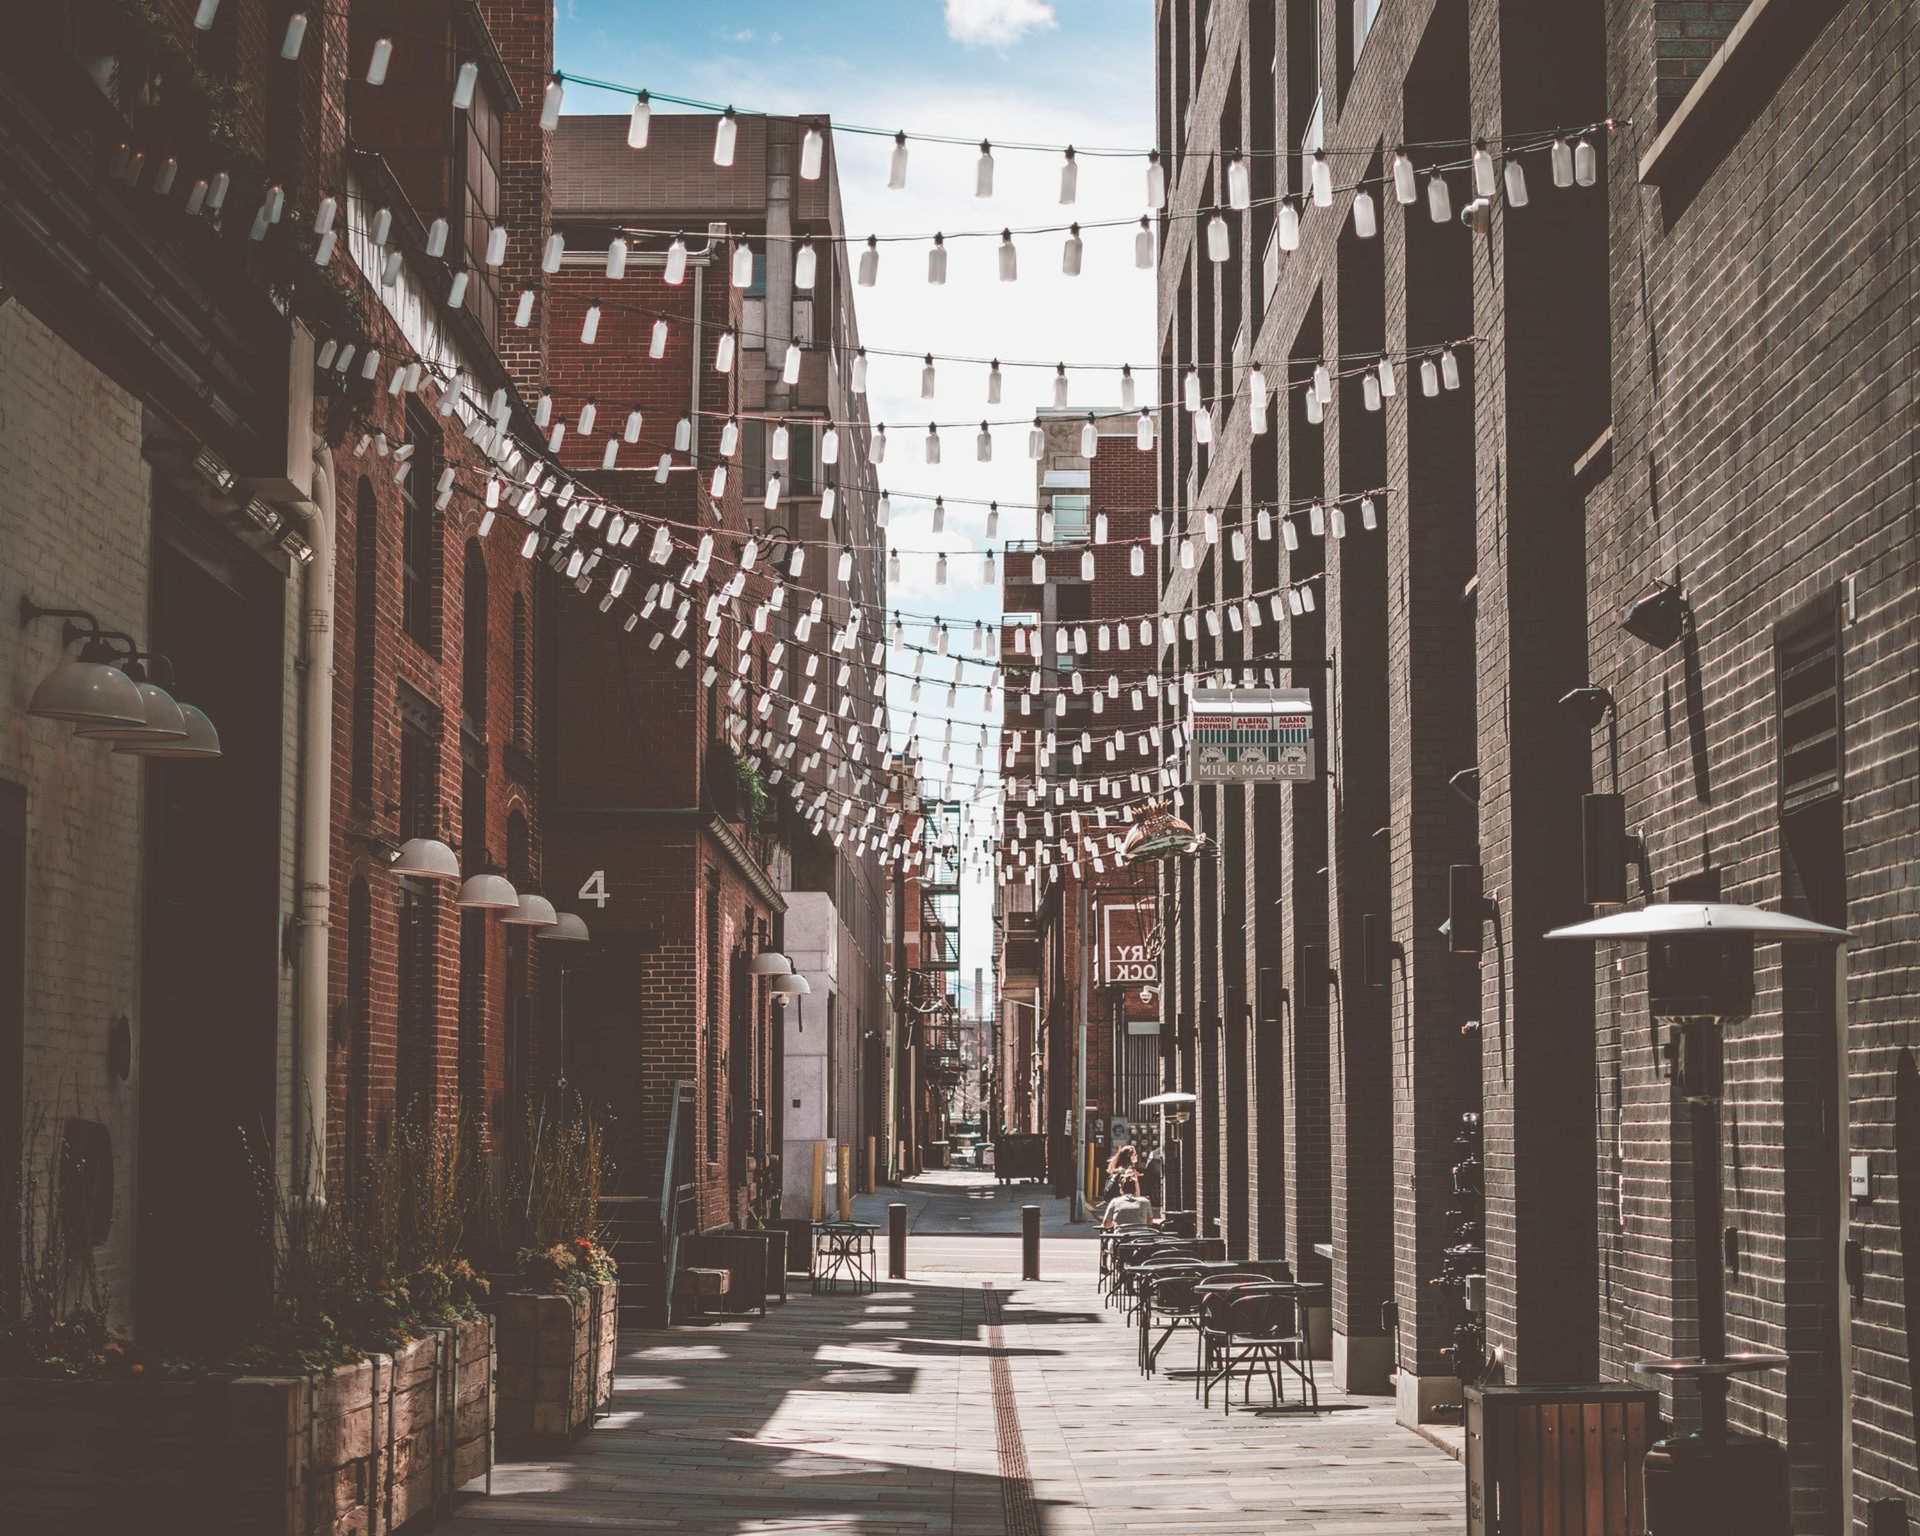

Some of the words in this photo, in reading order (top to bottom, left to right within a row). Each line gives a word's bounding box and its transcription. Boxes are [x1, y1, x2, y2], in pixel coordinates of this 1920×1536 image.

[1199, 764, 1236, 776] MILK
[1242, 764, 1306, 776] MARKET
[578, 870, 610, 908] 4
